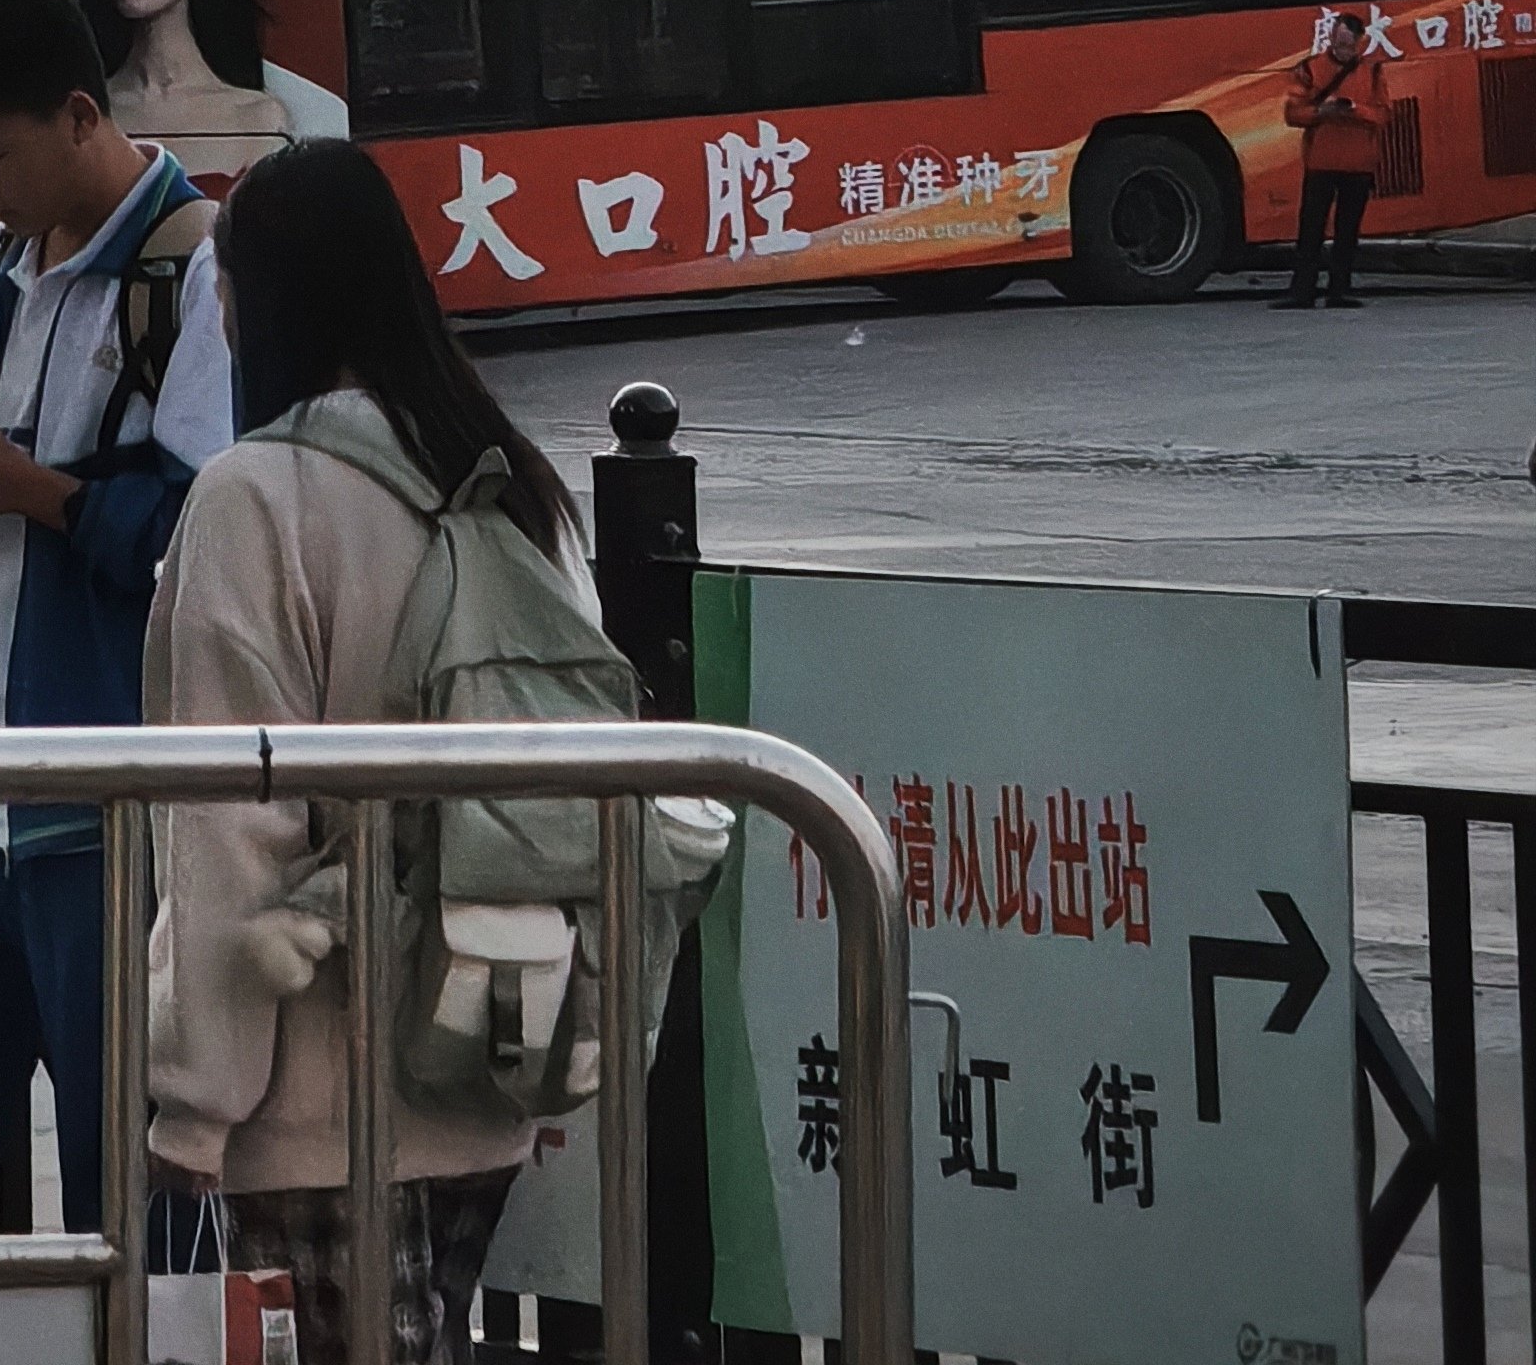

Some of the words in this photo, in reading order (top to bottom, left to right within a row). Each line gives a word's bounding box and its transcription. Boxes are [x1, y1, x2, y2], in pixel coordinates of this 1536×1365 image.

[436, 119, 811, 281] 大口腔
[838, 150, 1060, 215] 精准种牙
[789, 772, 1152, 947] 请从此出站
